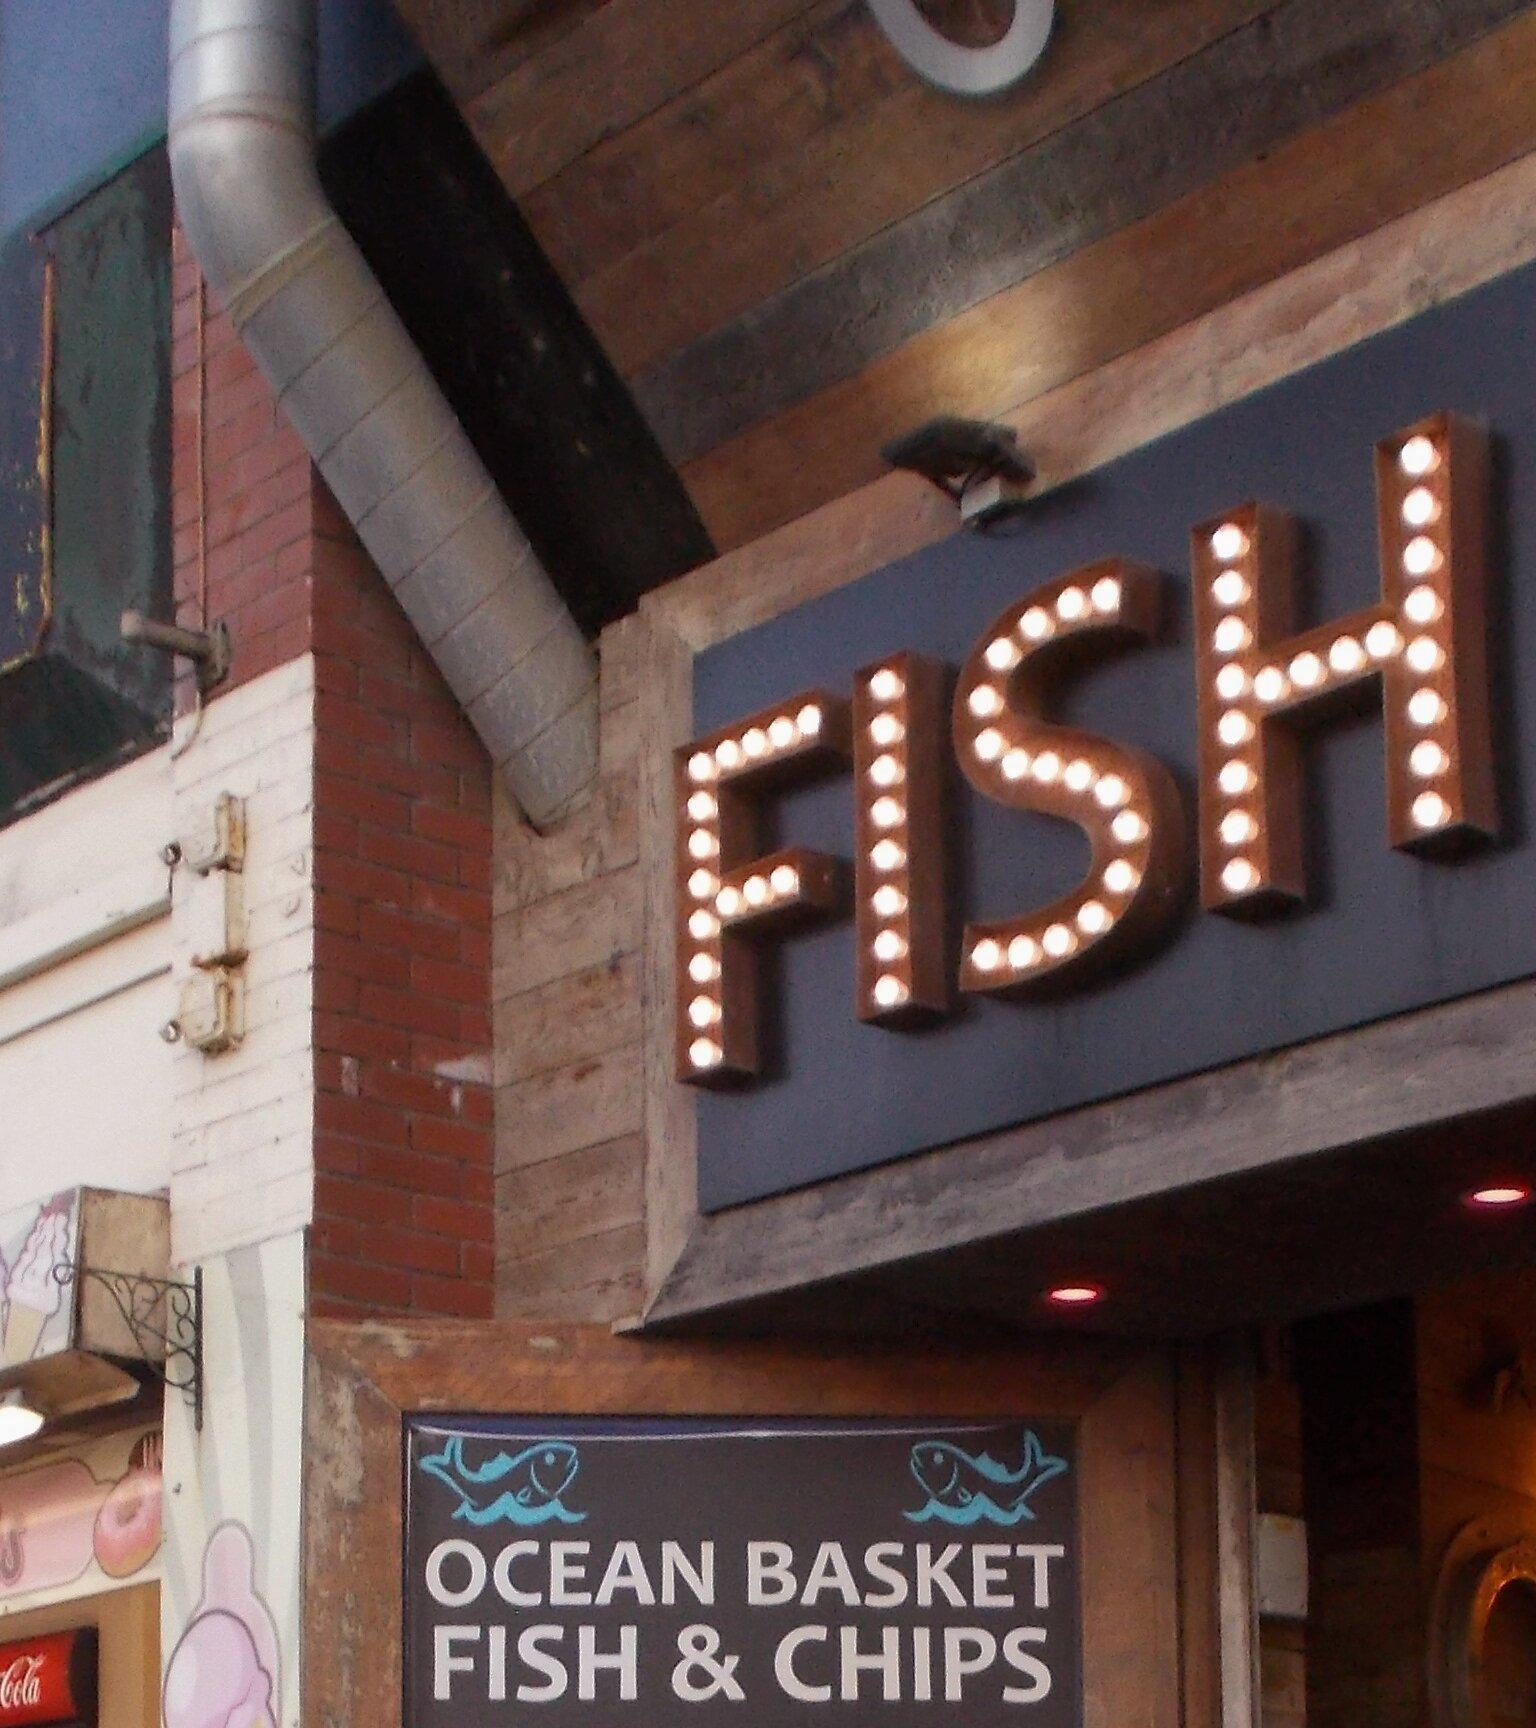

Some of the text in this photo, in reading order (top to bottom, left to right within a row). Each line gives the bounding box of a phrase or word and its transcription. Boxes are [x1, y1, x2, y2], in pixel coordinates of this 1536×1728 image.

[677, 413, 1499, 1087] FISH
[424, 1537, 1066, 1610] OCEAN BASKET
[433, 1622, 1053, 1704] FISH & CHIPS
